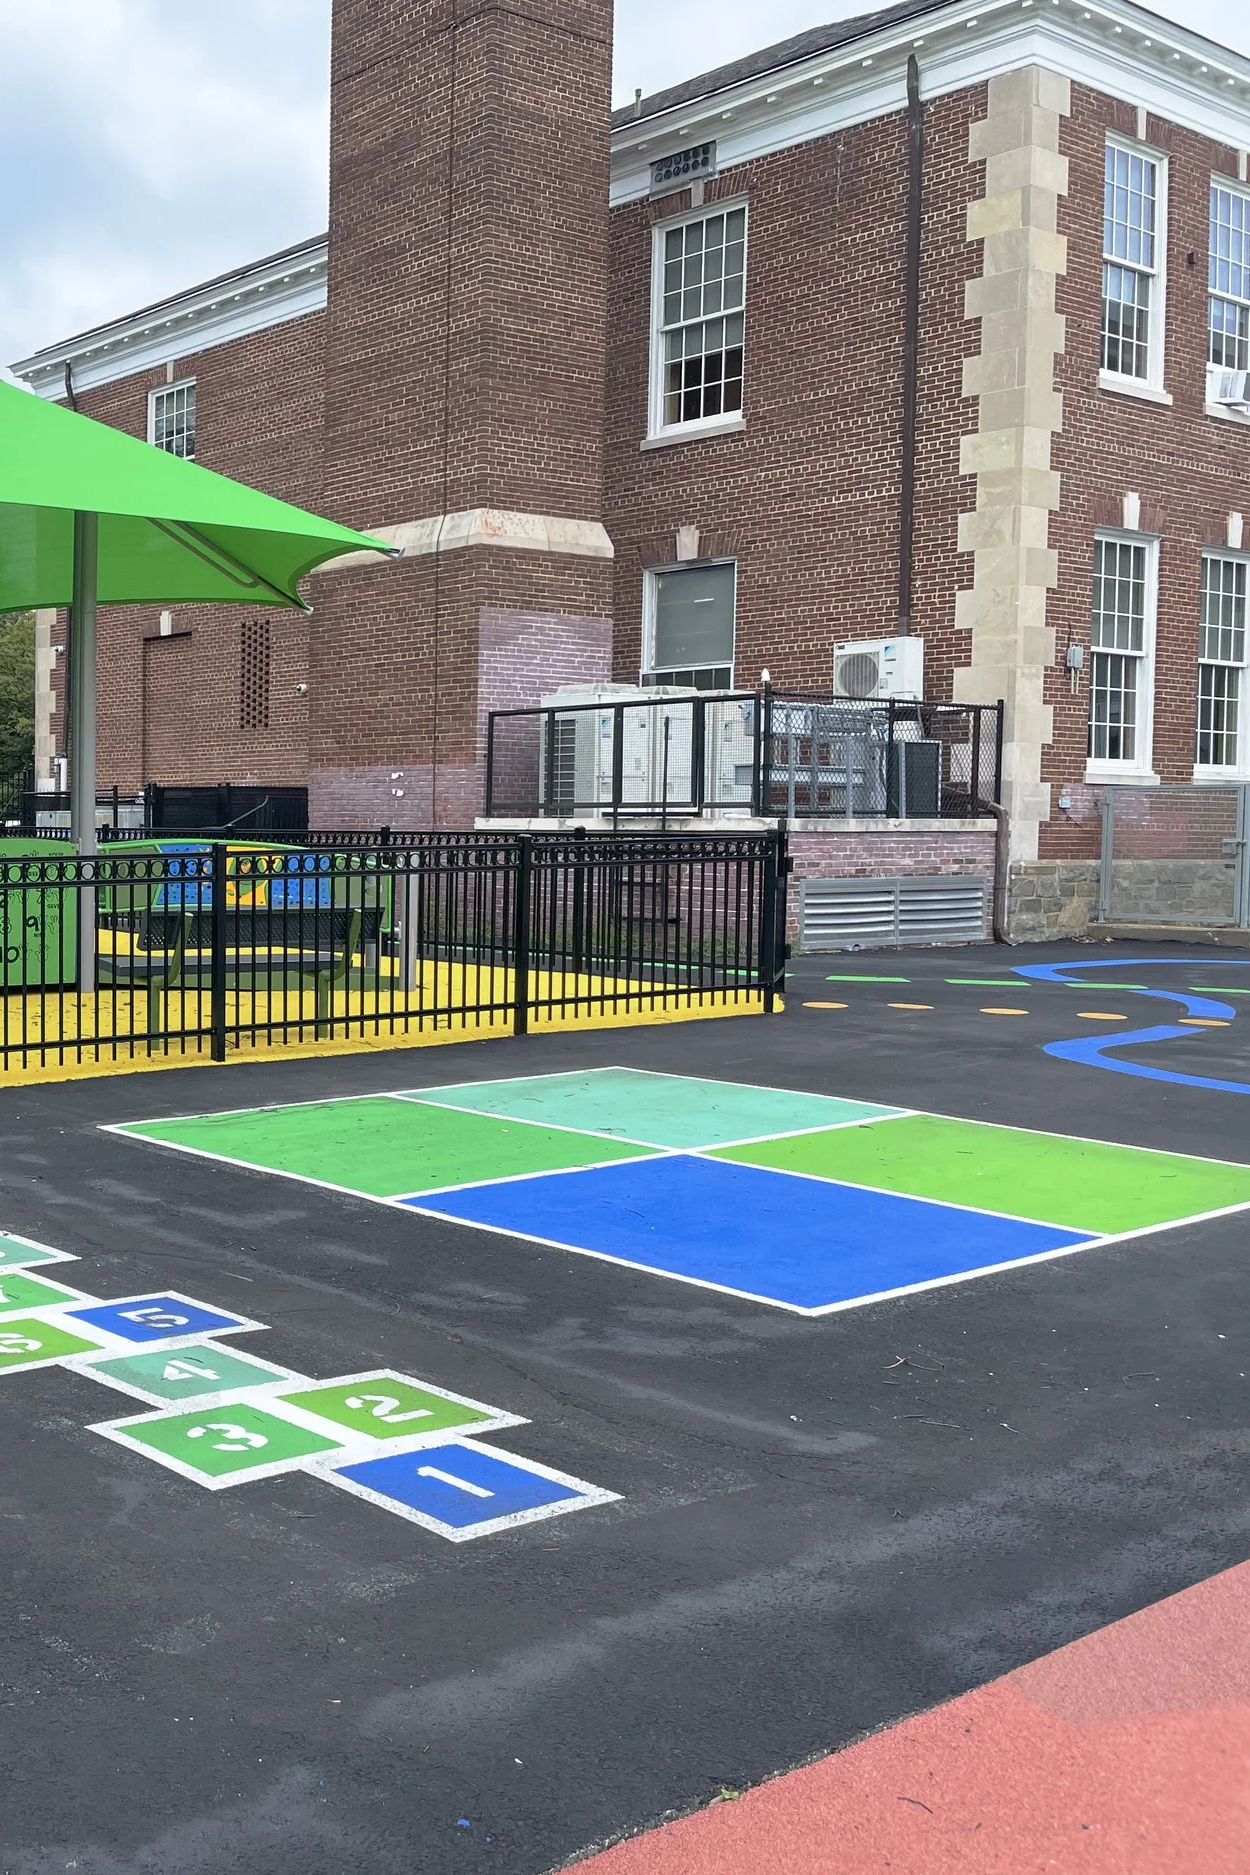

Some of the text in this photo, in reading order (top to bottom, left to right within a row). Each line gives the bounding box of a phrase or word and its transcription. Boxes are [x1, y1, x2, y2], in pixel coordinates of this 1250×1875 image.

[117, 1306, 190, 1328] 5
[162, 1359, 222, 1381] 4
[345, 1393, 436, 1424] 2
[186, 1423, 269, 1452] 3
[418, 1465, 495, 1498] 1
